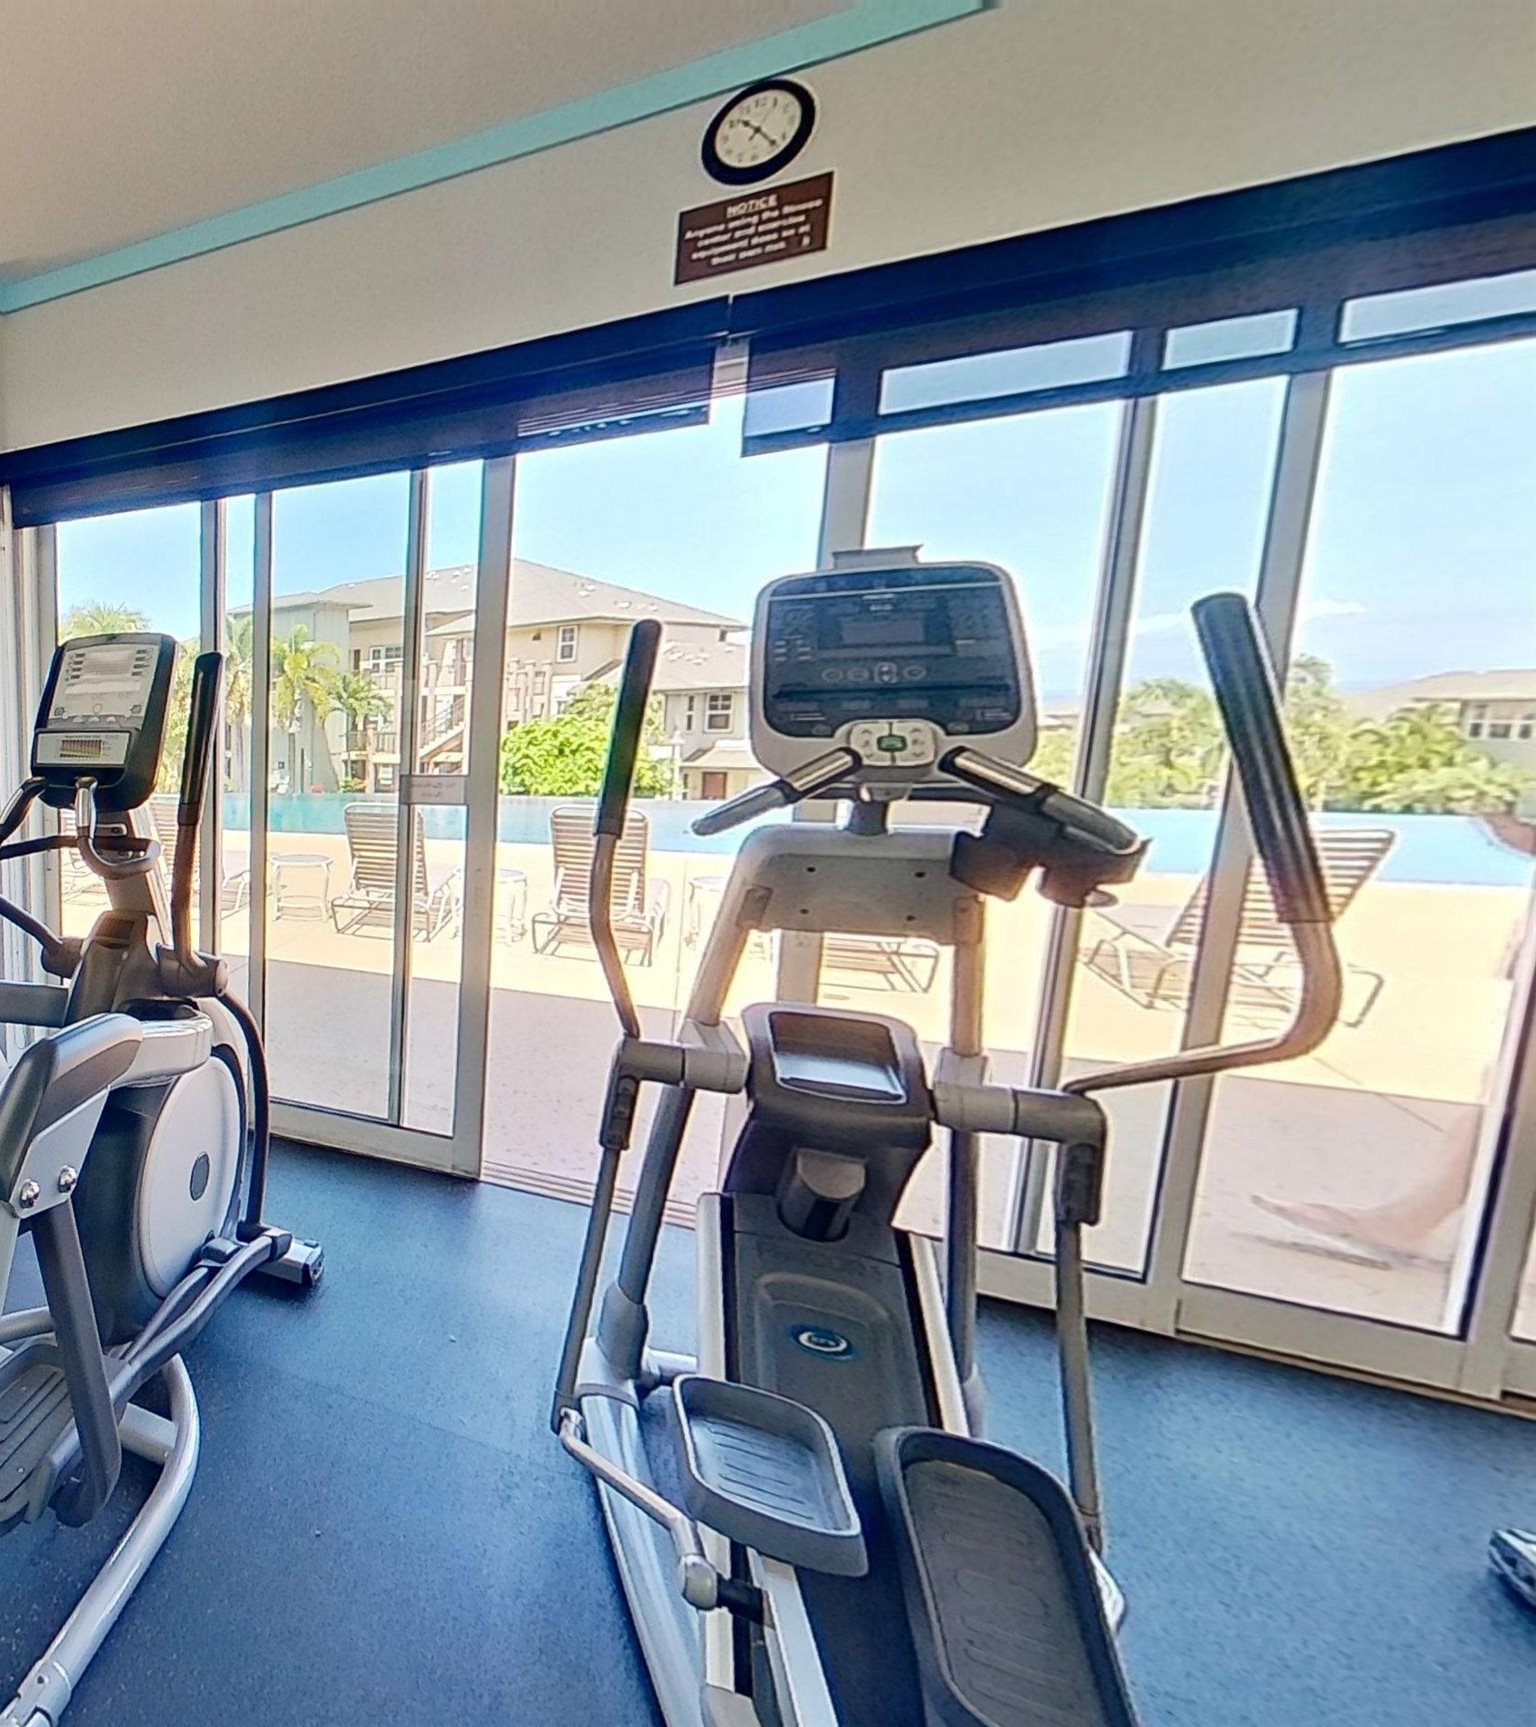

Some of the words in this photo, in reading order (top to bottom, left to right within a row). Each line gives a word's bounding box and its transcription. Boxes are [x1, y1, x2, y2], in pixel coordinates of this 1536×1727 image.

[726, 194, 778, 217] NOTICE
[761, 208, 780, 220] the
[734, 225, 756, 238] and
